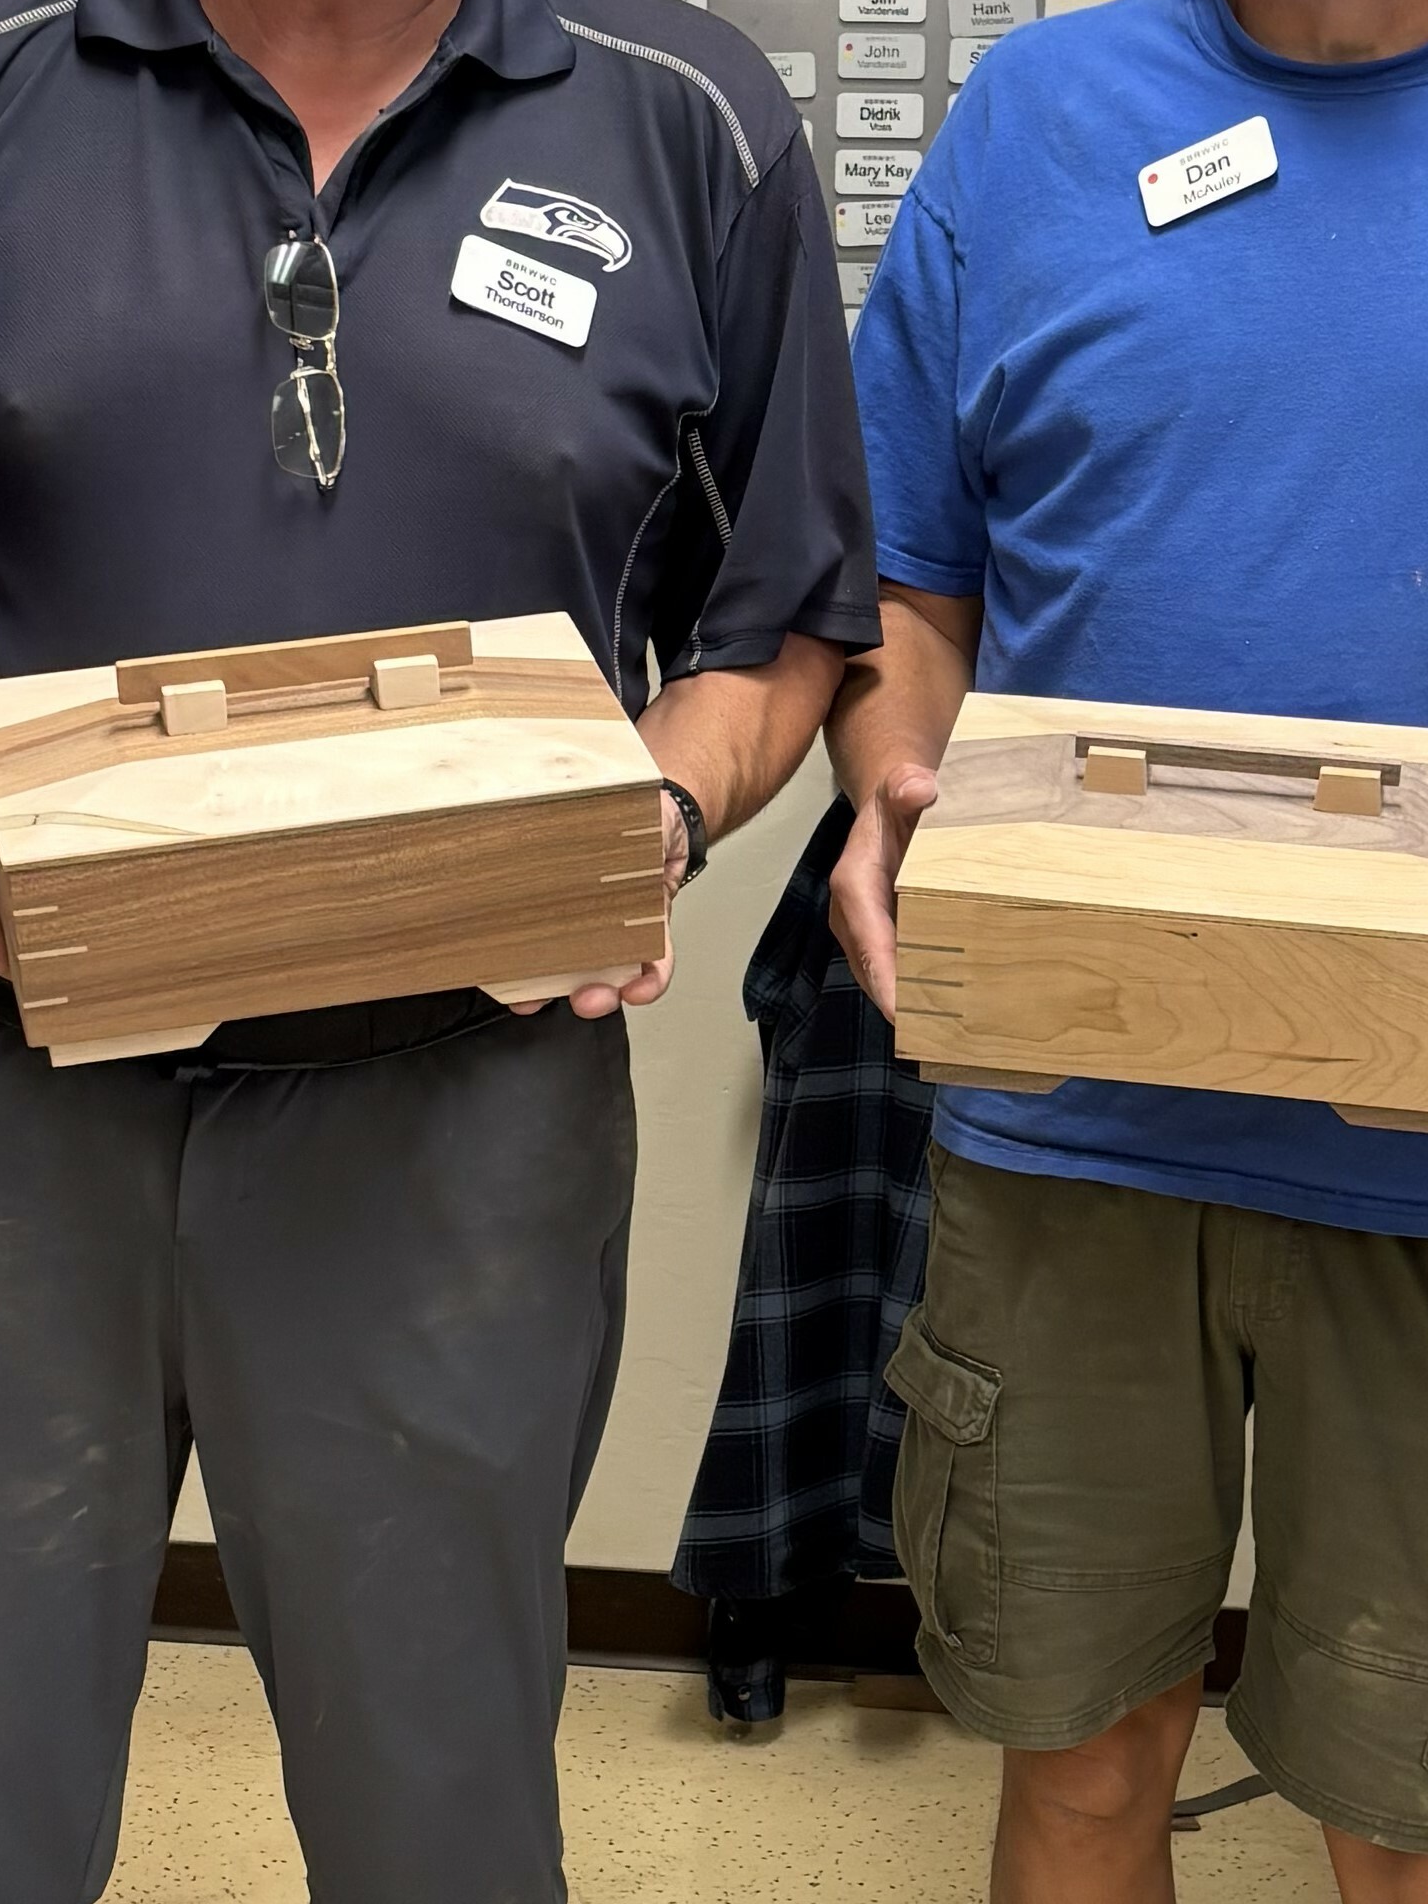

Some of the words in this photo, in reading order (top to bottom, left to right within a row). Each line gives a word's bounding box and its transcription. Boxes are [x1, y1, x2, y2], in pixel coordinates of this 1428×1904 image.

[973, 2, 1010, 15] Hank
[865, 46, 900, 59] John
[860, 108, 901, 121] Didrik
[845, 163, 880, 179] Mary
[885, 164, 912, 180] Kay
[1186, 156, 1231, 185] Dan
[1183, 172, 1241, 204] McAuley
[865, 213, 891, 225] Lee
[497, 270, 556, 309] Scott
[485, 285, 564, 329] Thordarson
